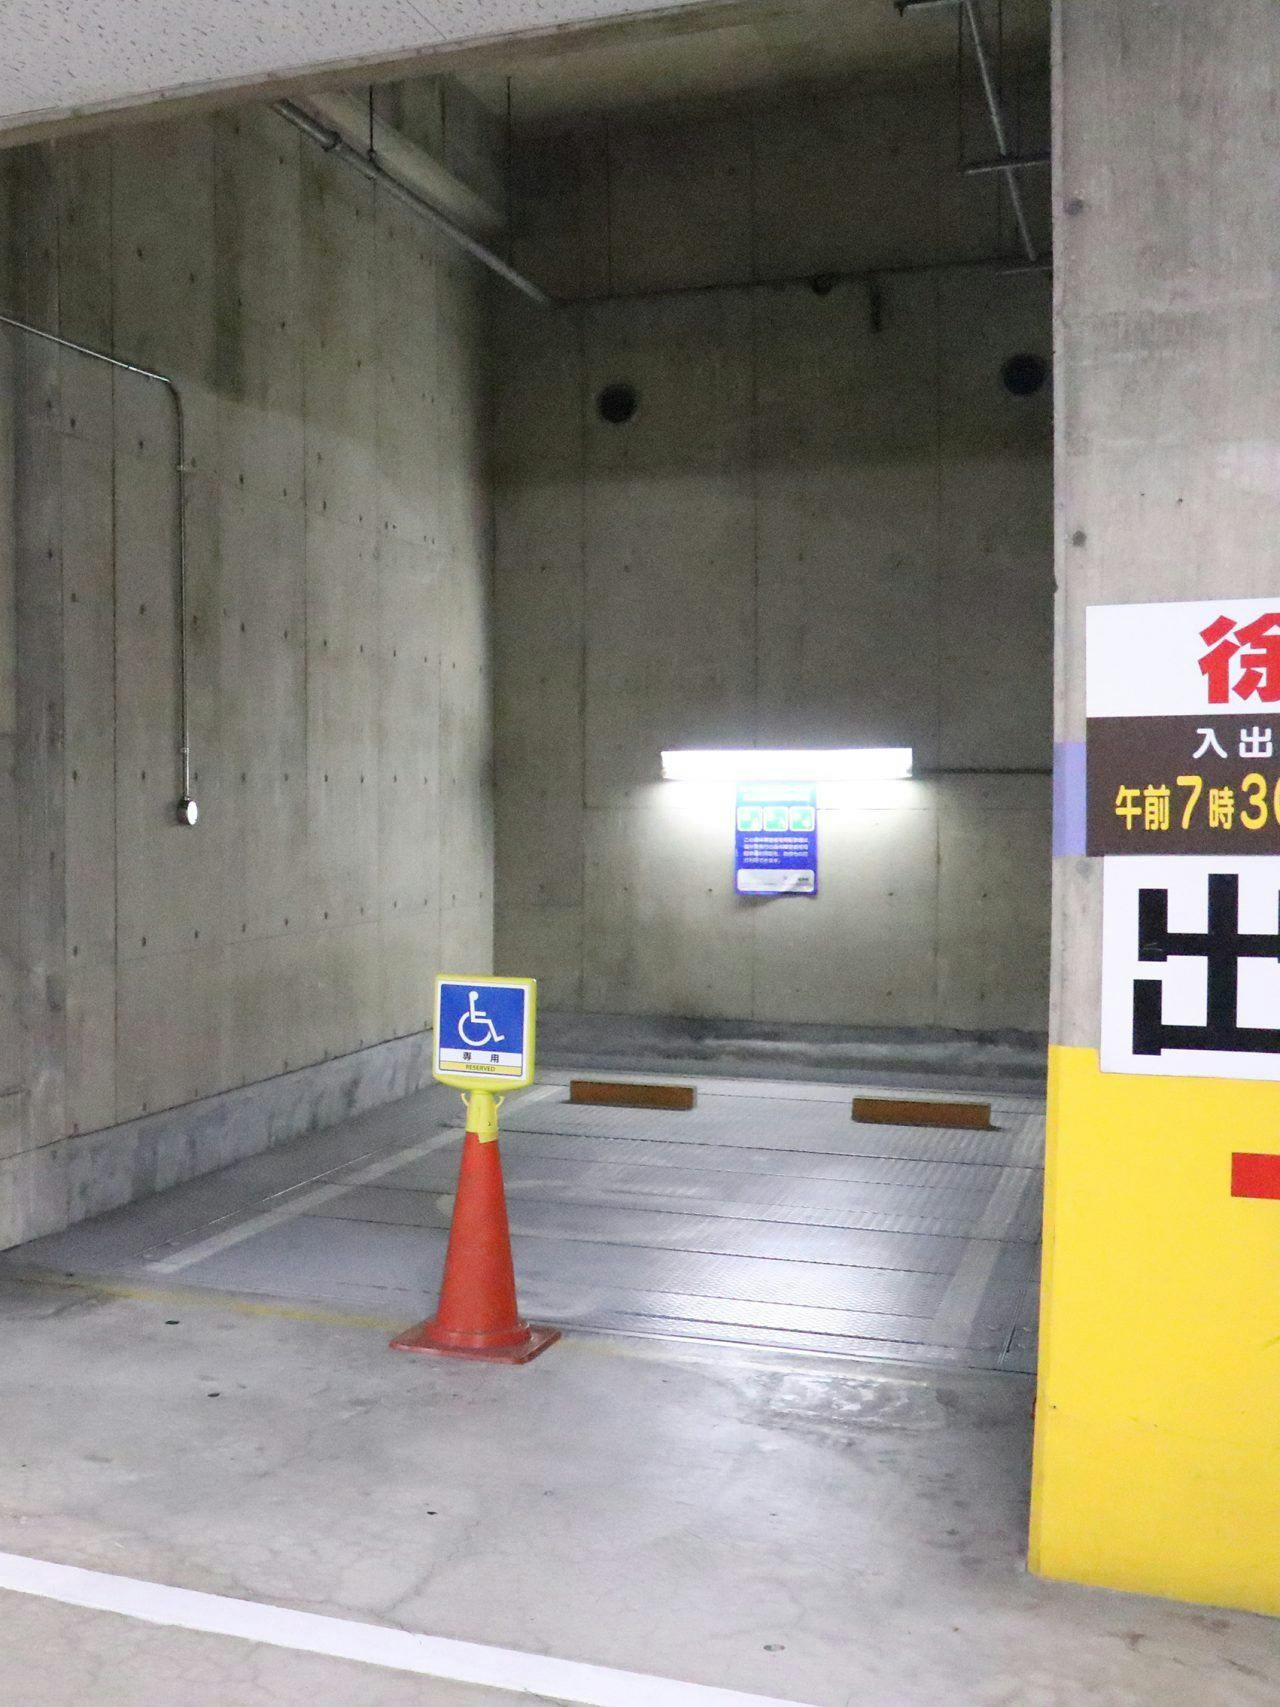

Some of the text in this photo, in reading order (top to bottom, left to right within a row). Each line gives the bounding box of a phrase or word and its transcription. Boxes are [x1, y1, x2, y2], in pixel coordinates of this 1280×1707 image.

[1115, 773, 1280, 830] 午前7時3
[465, 1064, 496, 1072] RESERVED
